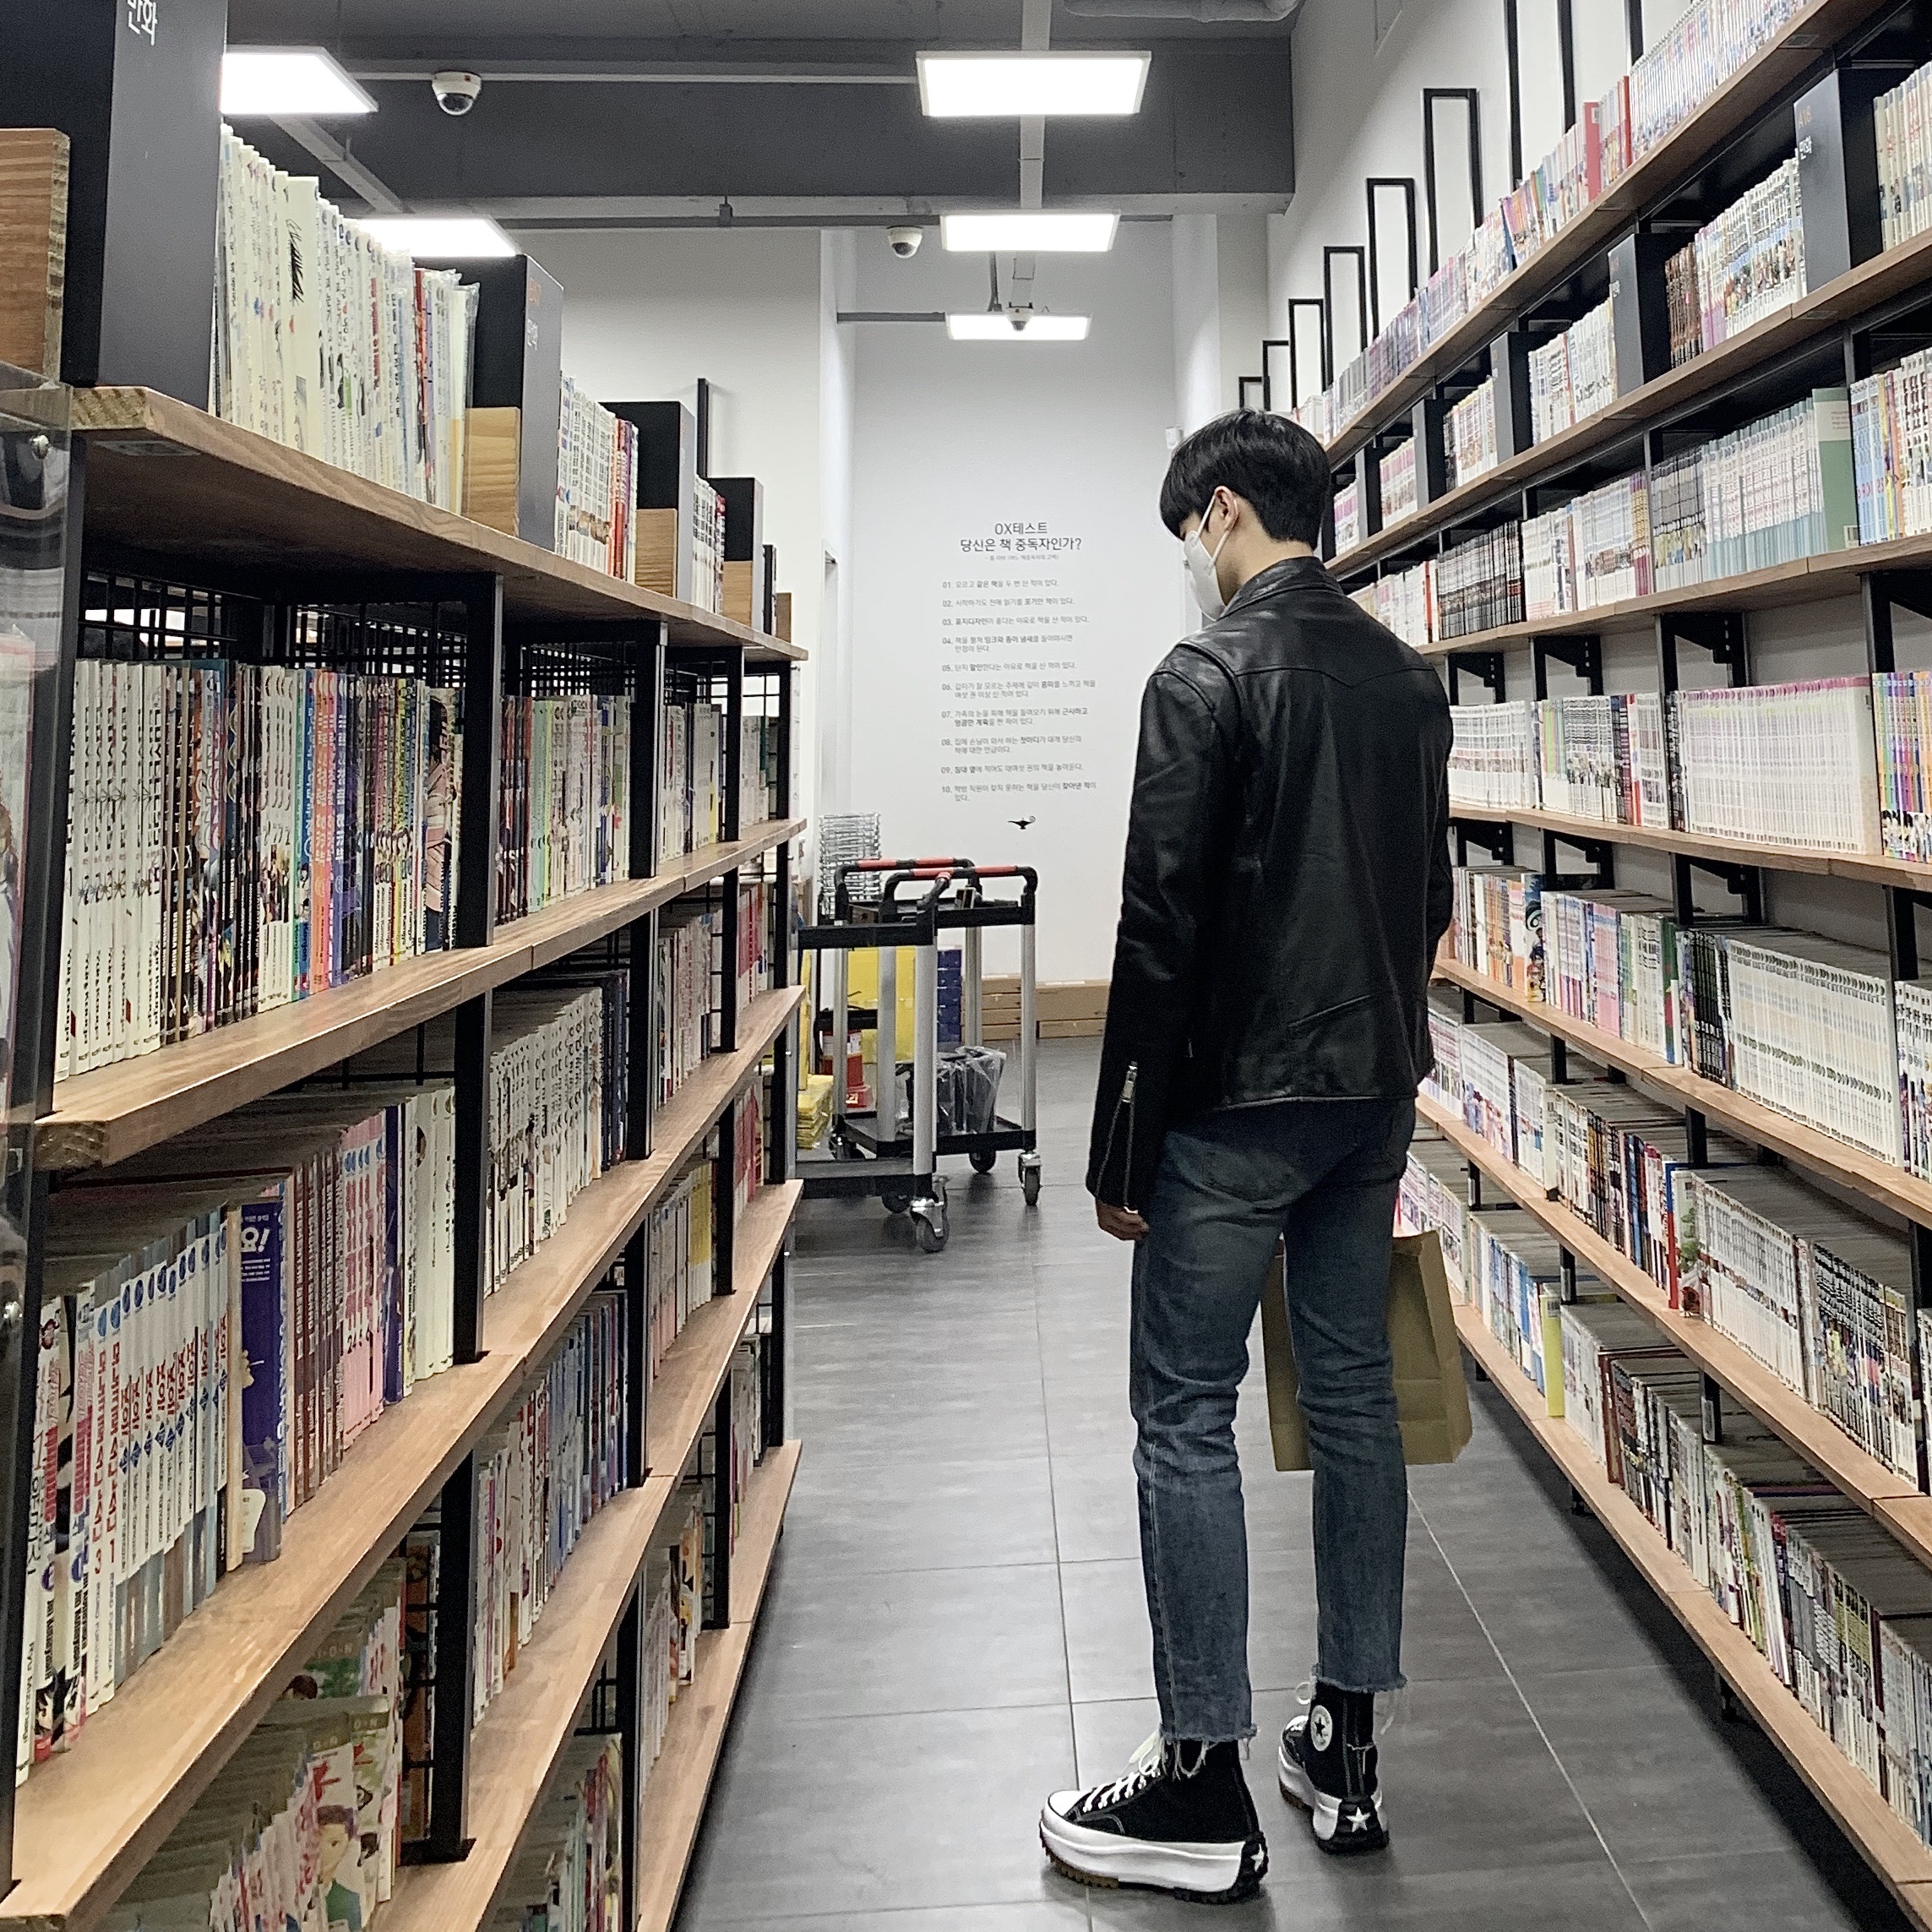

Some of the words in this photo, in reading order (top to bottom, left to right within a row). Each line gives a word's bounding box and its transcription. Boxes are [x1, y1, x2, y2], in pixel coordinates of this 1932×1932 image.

[994, 522, 1048, 535] OX테스트
[961, 539, 996, 552] 당신은
[999, 539, 1011, 550] 책
[1015, 537, 1082, 551] 중독자인가?
